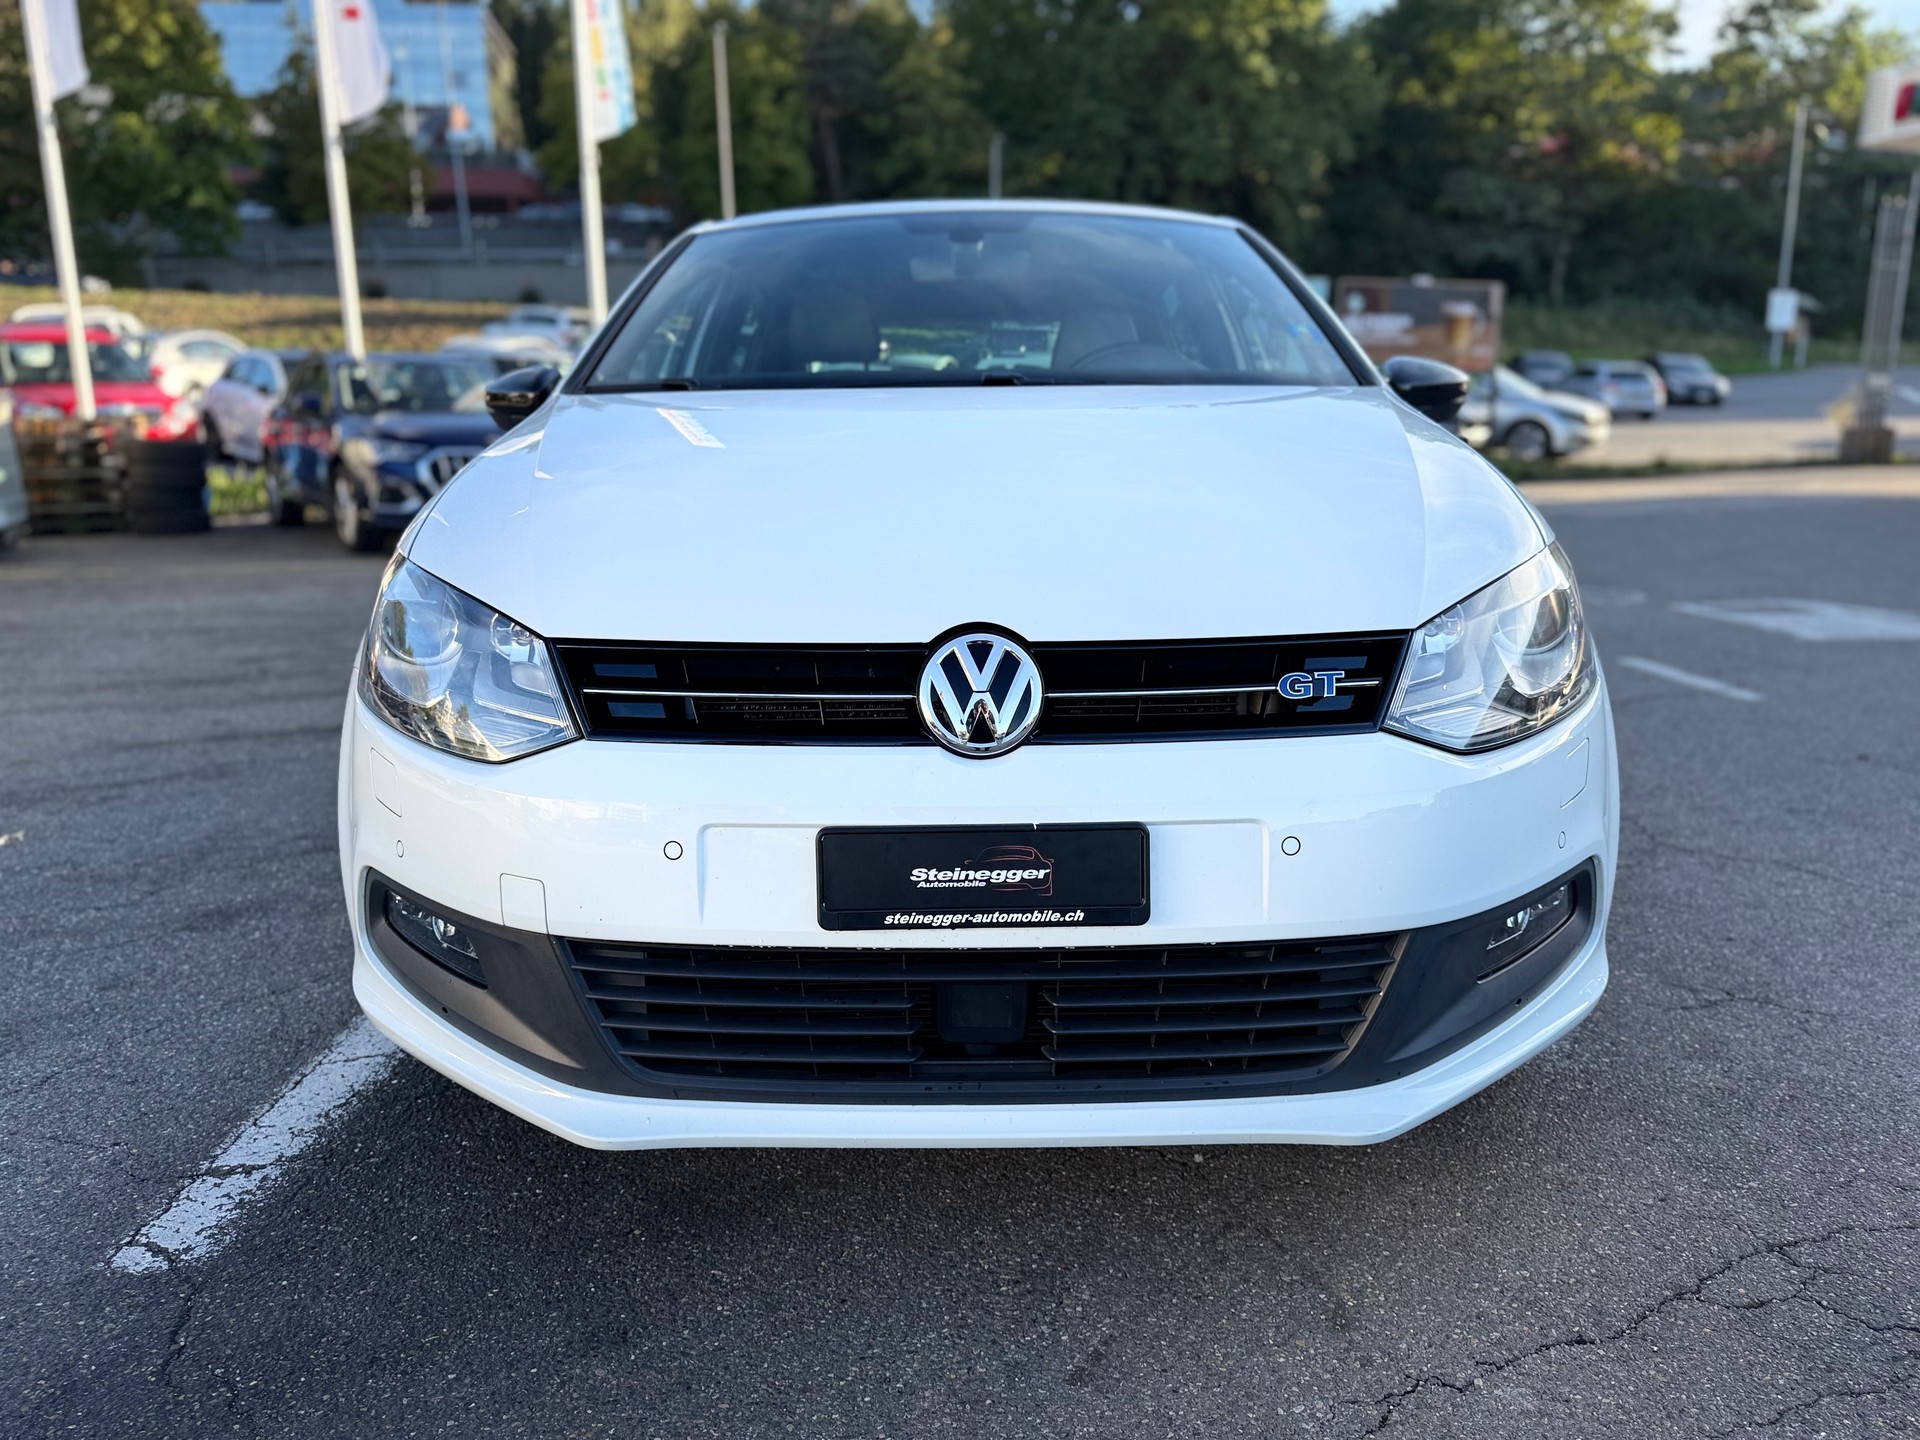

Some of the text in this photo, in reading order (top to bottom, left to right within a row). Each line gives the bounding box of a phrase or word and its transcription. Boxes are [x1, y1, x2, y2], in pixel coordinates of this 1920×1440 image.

[1277, 670, 1345, 699] GT
[910, 868, 1050, 882] Steinegger
[884, 911, 1084, 926] steinegger-automobile.ch
